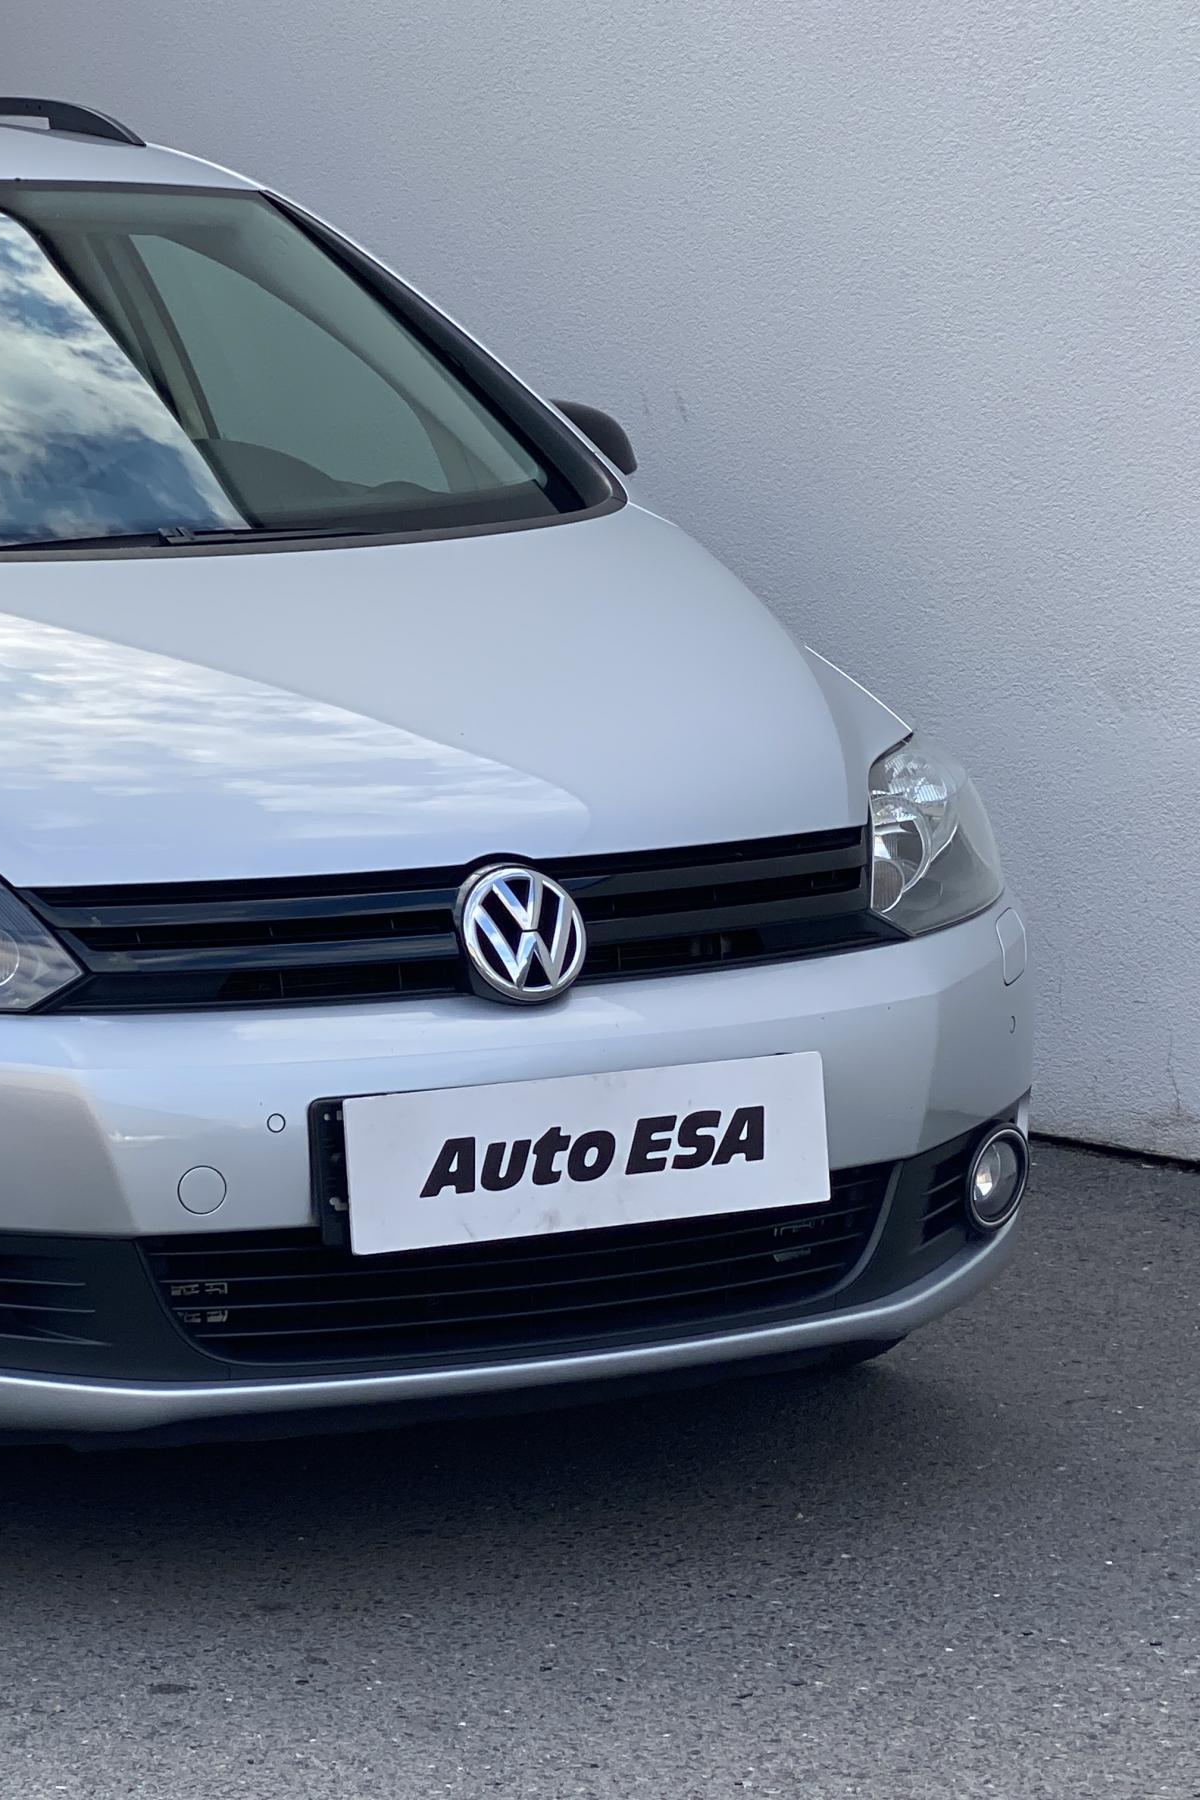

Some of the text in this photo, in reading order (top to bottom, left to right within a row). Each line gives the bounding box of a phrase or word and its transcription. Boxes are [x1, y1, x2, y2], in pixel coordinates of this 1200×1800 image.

[466, 867, 584, 994] VW
[419, 1105, 765, 1199] Auto ESA
